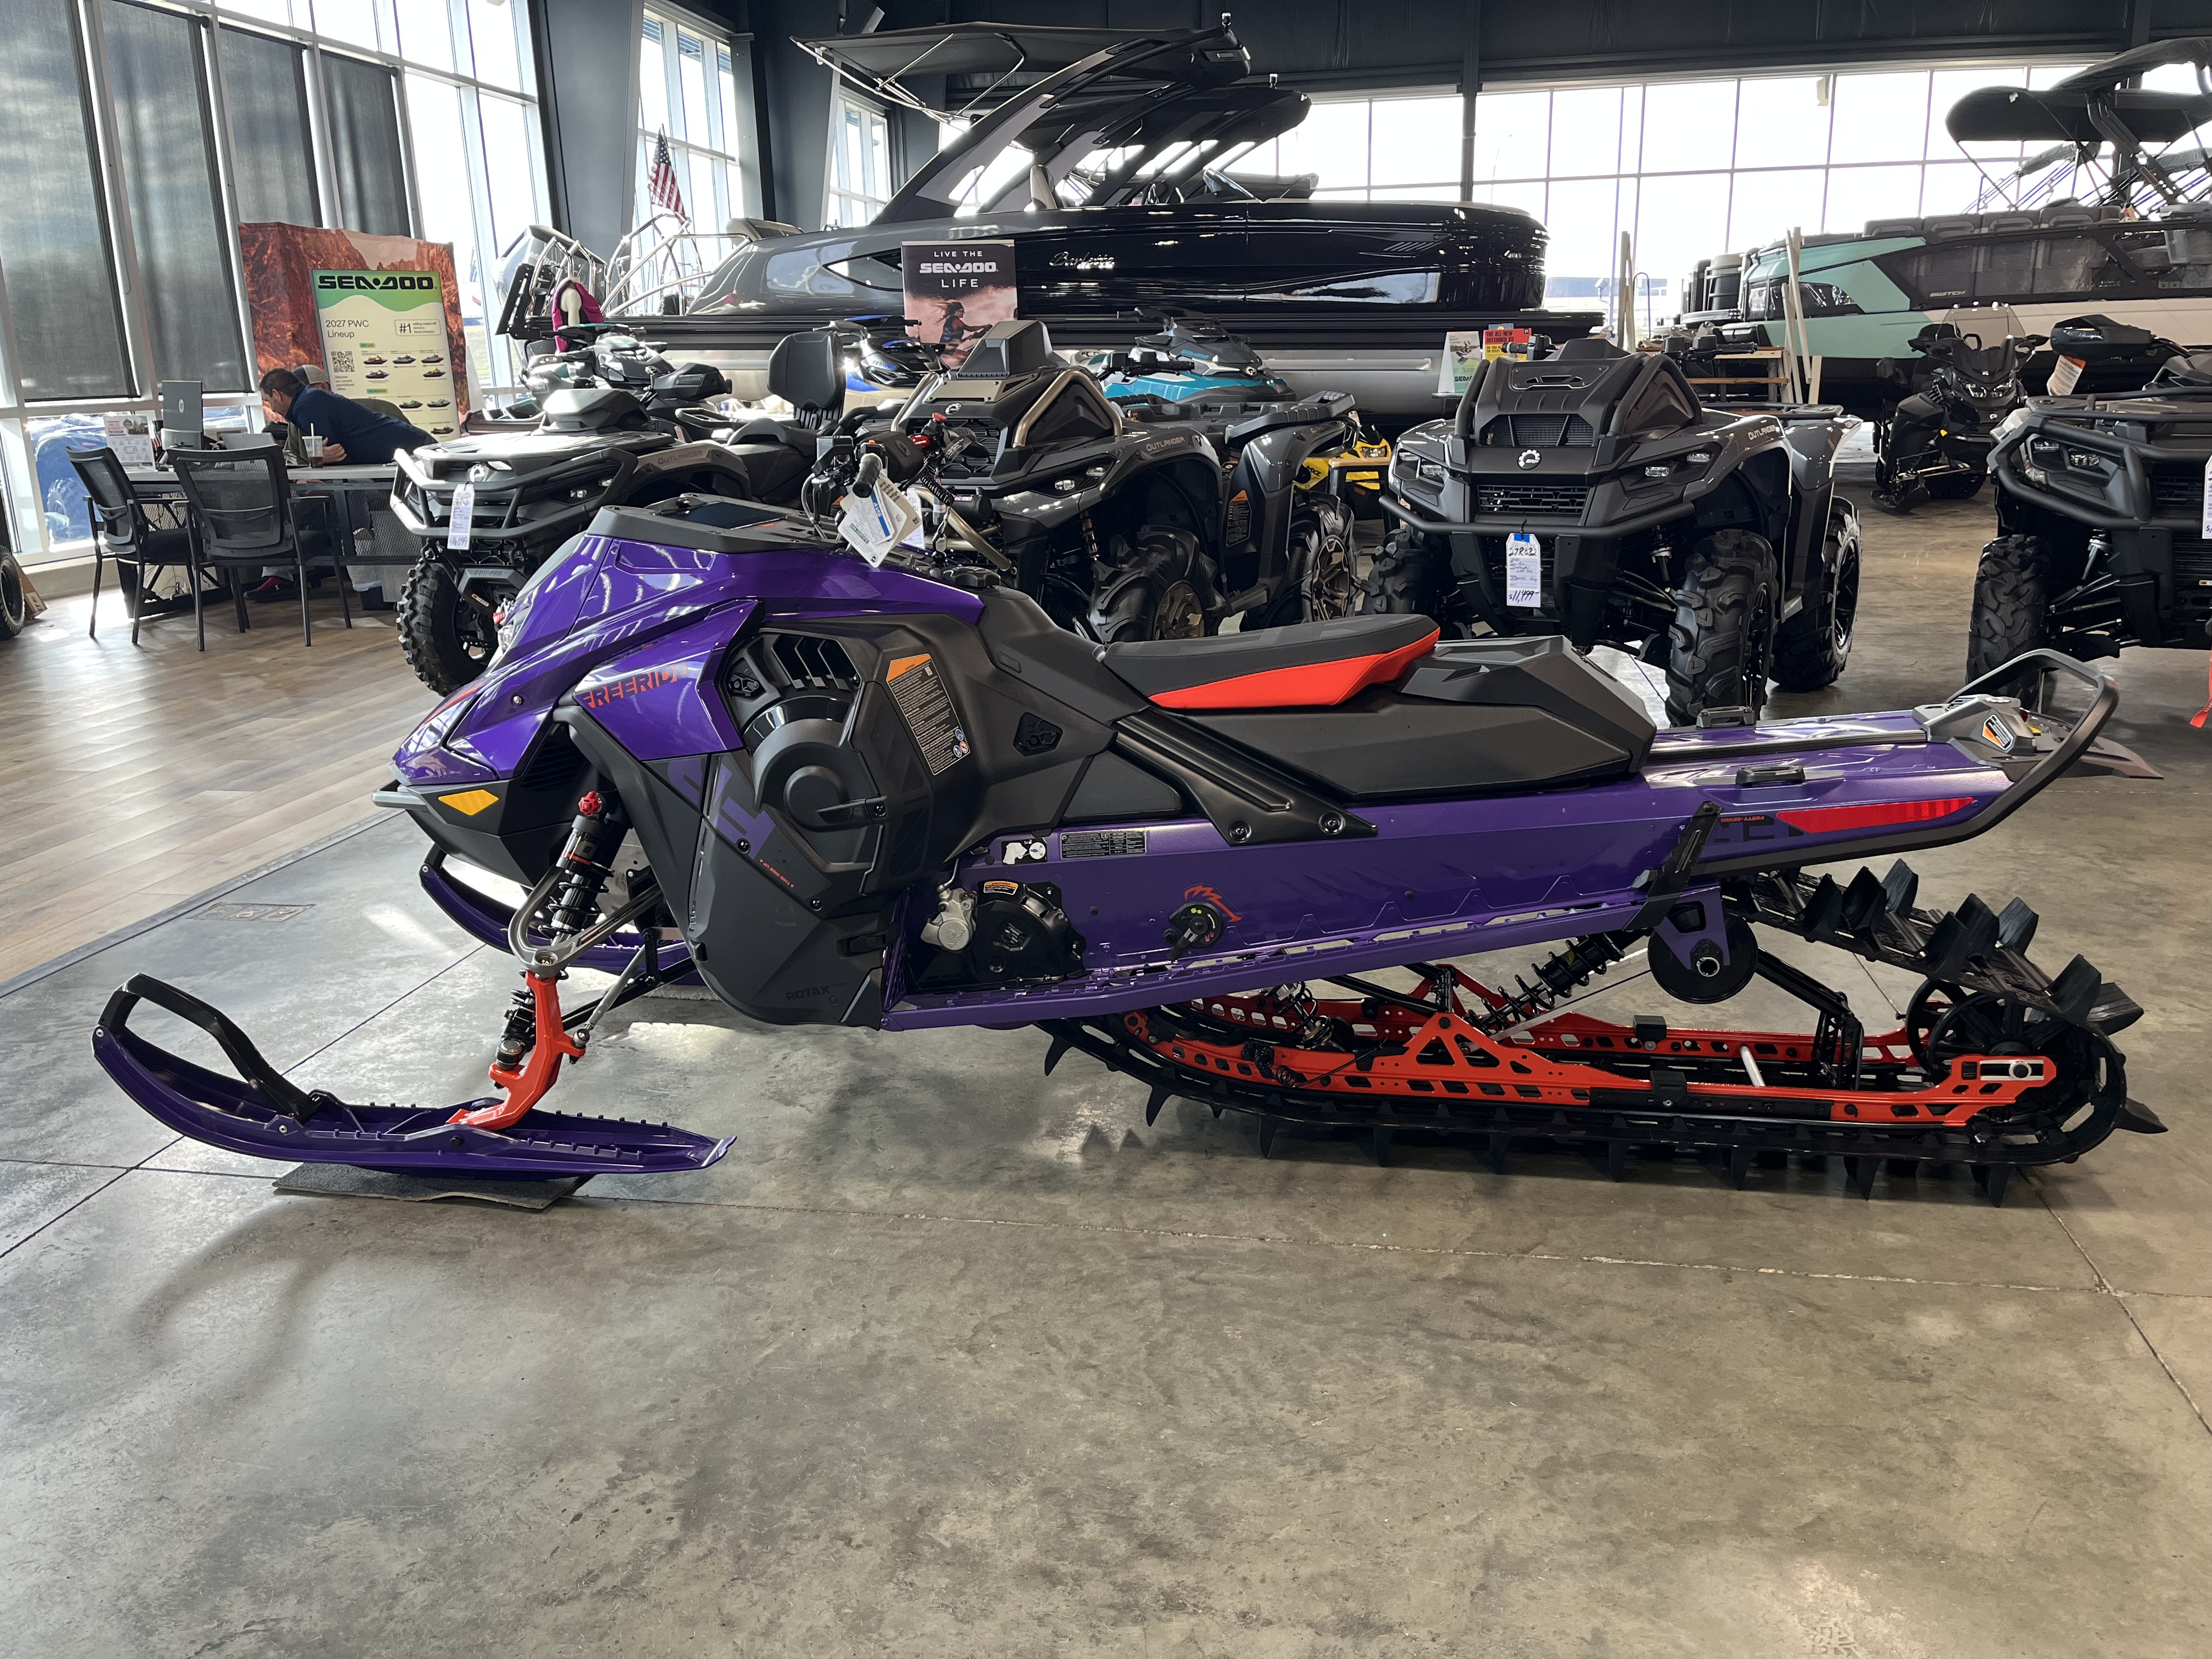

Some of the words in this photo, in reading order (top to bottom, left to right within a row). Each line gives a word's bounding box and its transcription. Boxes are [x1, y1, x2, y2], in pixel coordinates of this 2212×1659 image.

[941, 279, 979, 288] LIFE
[328, 330, 355, 339] Lineup
[399, 323, 411, 334] #1
[1146, 437, 1185, 451] OUTLANDER
[658, 450, 703, 464] OUTLANDER
[873, 503, 882, 517] AVIS
[579, 663, 690, 708] FREERIDE
[786, 985, 831, 1001] ROTAX
